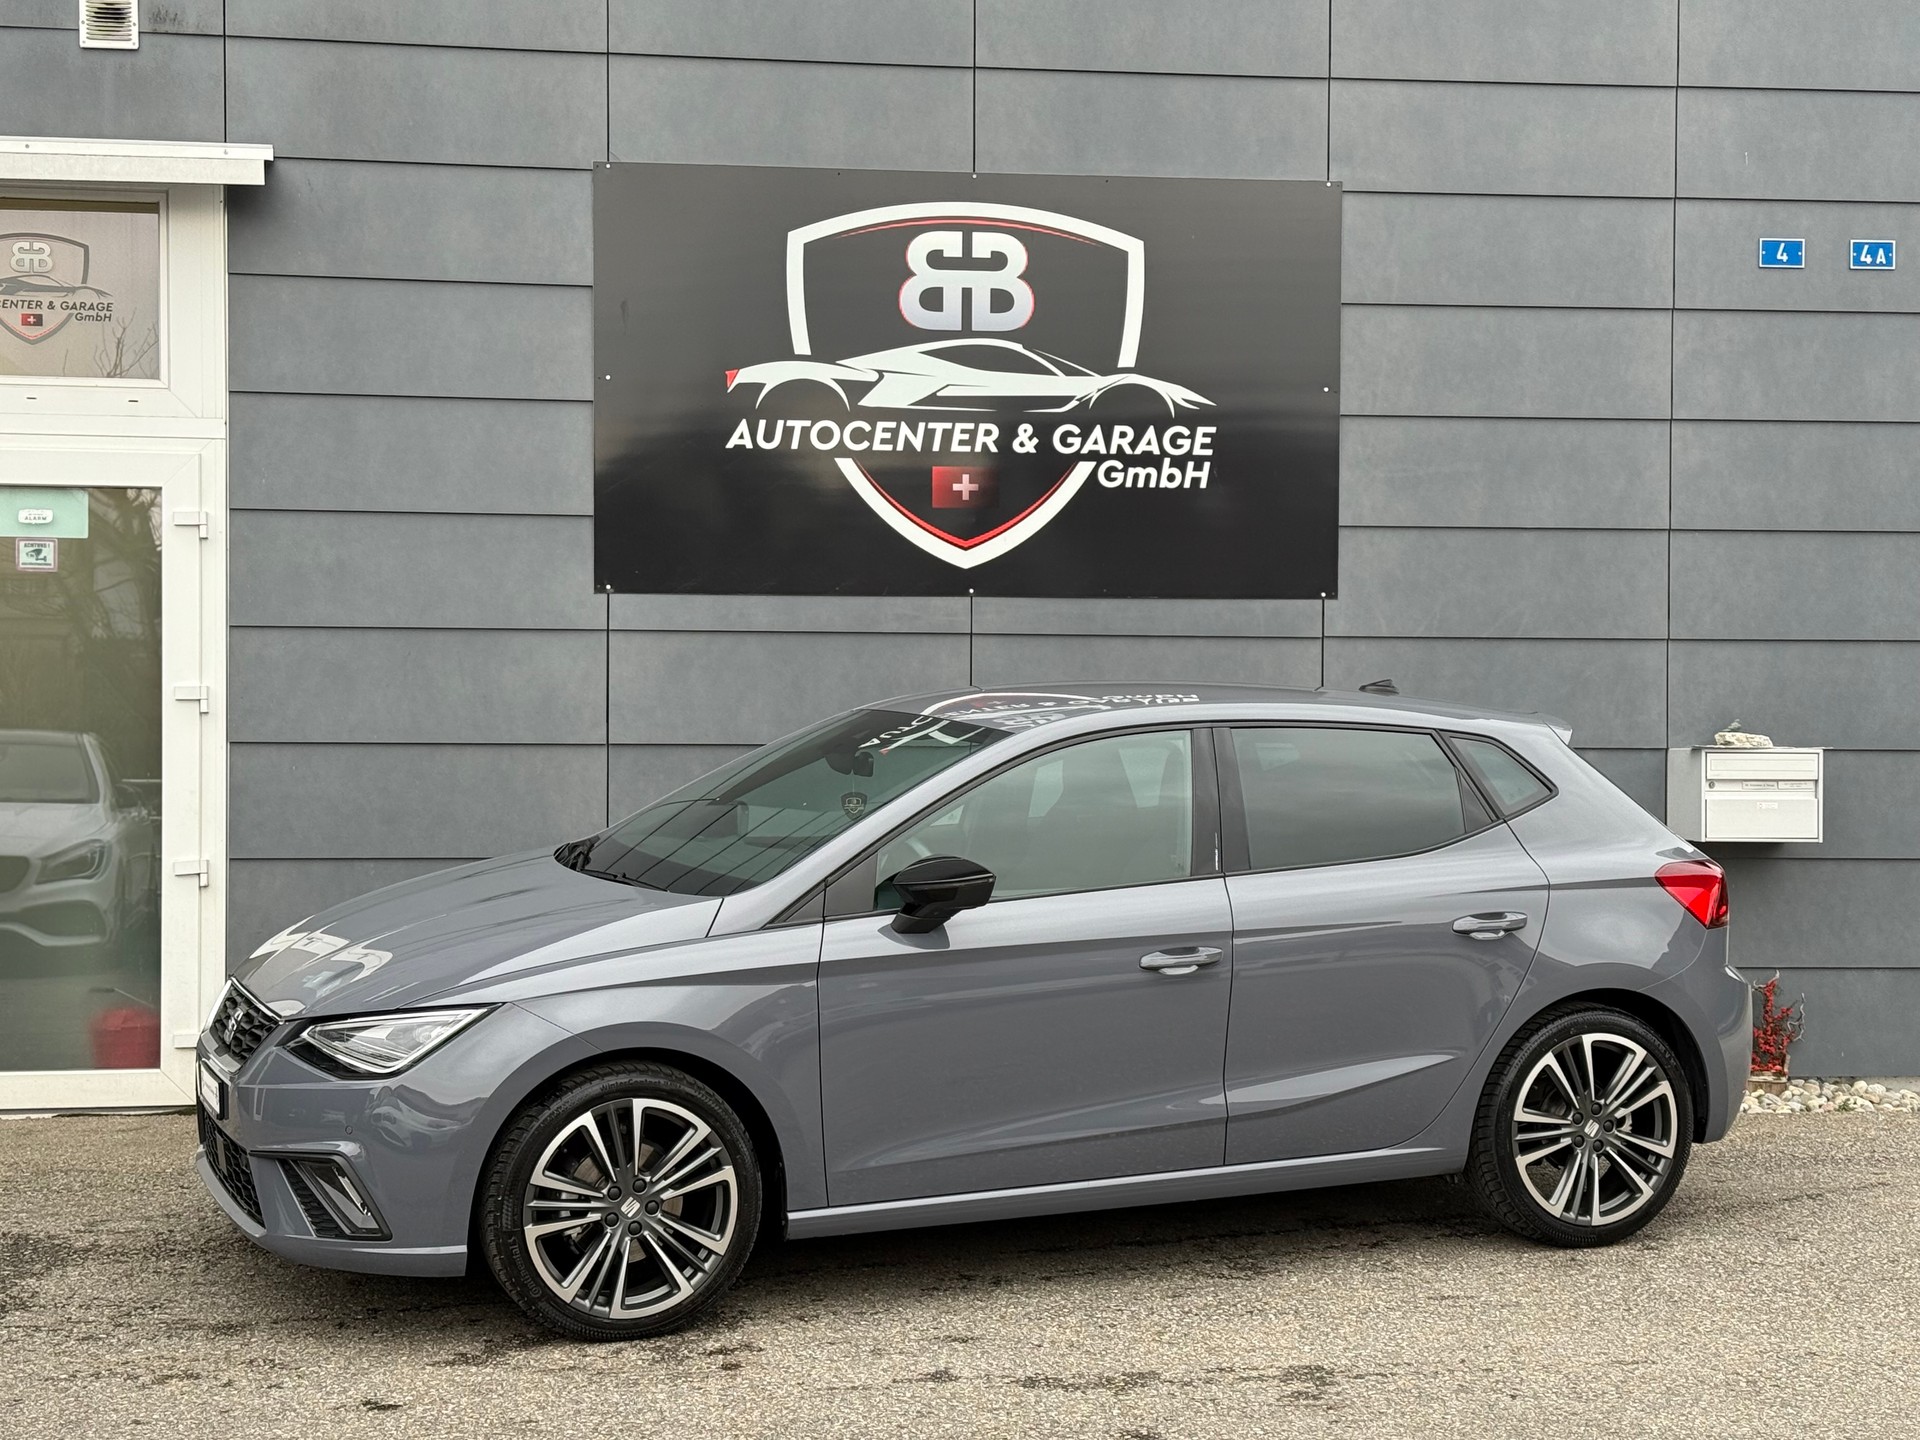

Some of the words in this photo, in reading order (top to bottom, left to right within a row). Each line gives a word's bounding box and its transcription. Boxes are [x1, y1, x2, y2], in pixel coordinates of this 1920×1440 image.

[1776, 242, 1788, 262] 4
[0, 299, 43, 310] ENTER
[47, 301, 56, 310] &
[60, 301, 114, 312] GARAGE
[75, 312, 112, 322] GmbH
[725, 418, 999, 452] AUTOCENTER
[1012, 423, 1039, 454] &
[1052, 424, 1217, 456] GARAGE
[1097, 458, 1211, 489] GmbH
